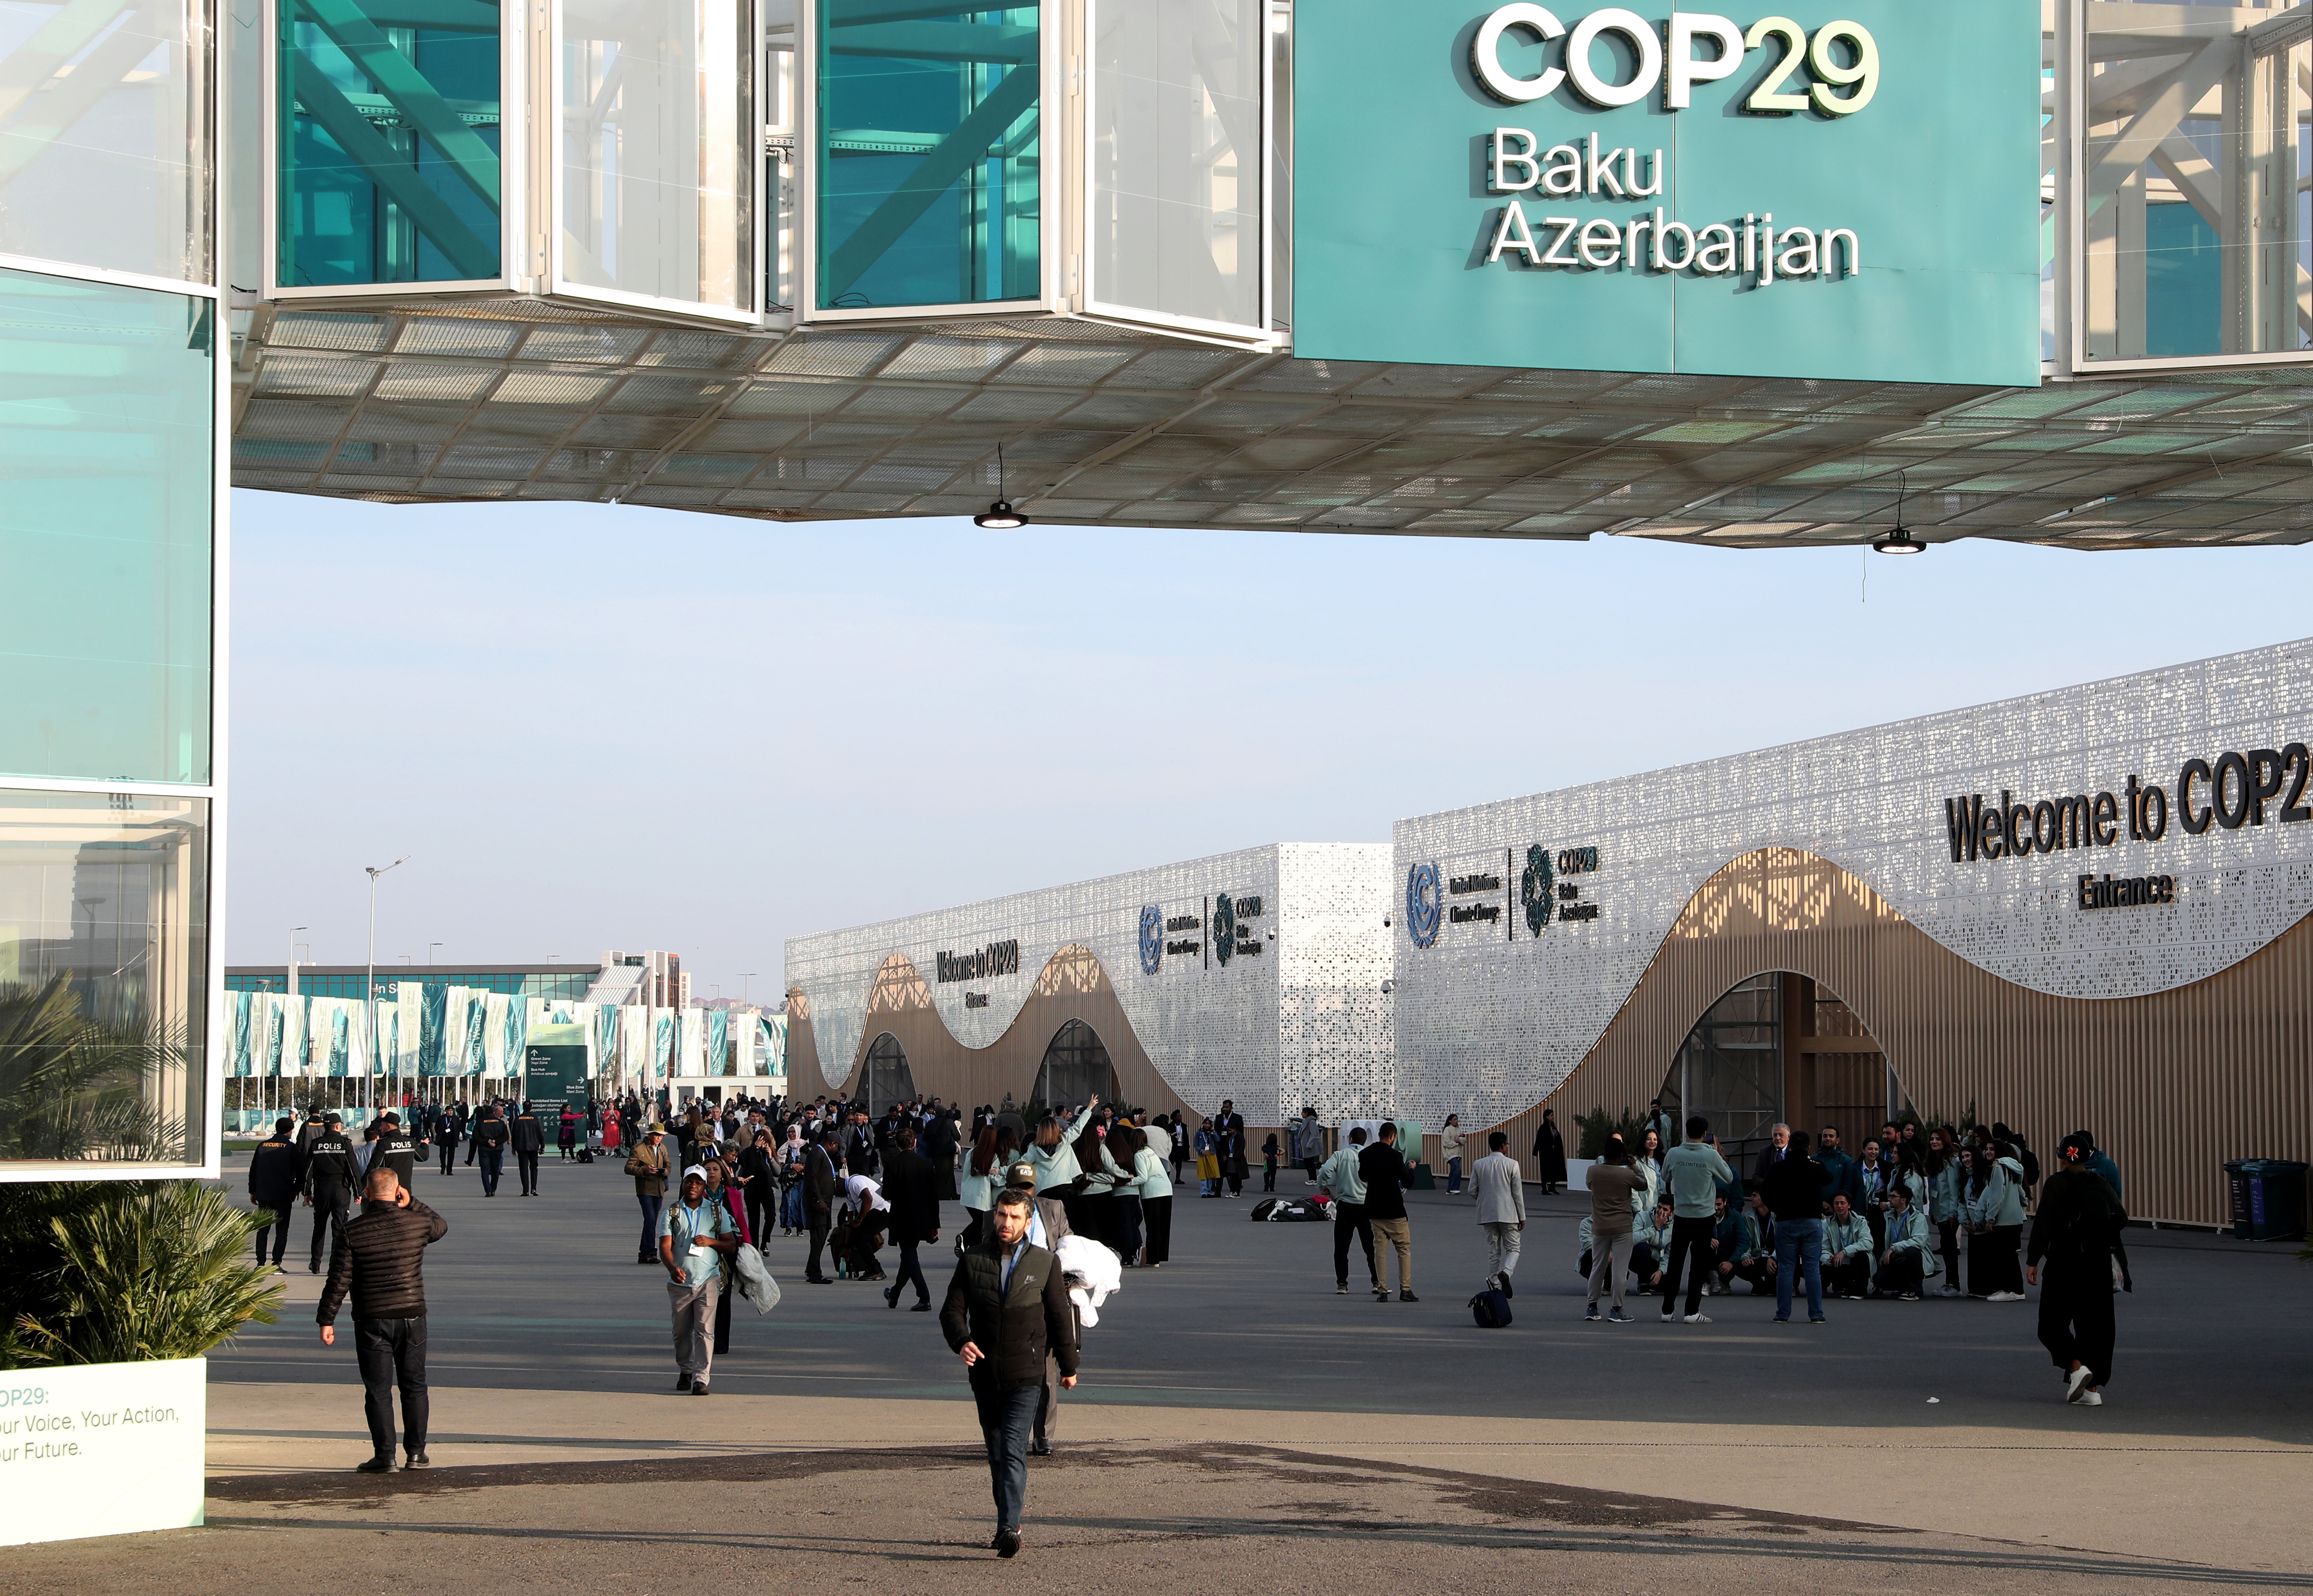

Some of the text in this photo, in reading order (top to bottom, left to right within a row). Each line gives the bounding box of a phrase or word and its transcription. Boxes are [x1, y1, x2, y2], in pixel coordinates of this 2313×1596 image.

[1474, 2, 1880, 117] COP29
[1489, 127, 1663, 195] Baku
[1489, 200, 1859, 287] Azerbaijan
[1944, 742, 2313, 863] Welcome to COP2
[1558, 846, 1598, 875] COP29
[1450, 874, 1499, 895] United Nations
[1558, 883, 1578, 901] Baku
[2078, 873, 2174, 910] Entrance
[1236, 896, 1262, 918] COP29
[1450, 903, 1499, 924] Climate Change
[1558, 902, 1598, 923] Azerbaijan
[1167, 915, 1199, 932] United Nations
[1236, 924, 1248, 938] Baku
[937, 939, 1018, 983] Welcome to COP29
[966, 992, 987, 1008] Entrance
[472, 1015, 482, 1071] Green World
[0, 1387, 49, 1407] OP29:
[0, 1406, 180, 1435] ur Voice, Your Action,
[0, 1442, 82, 1462] ur Future.
